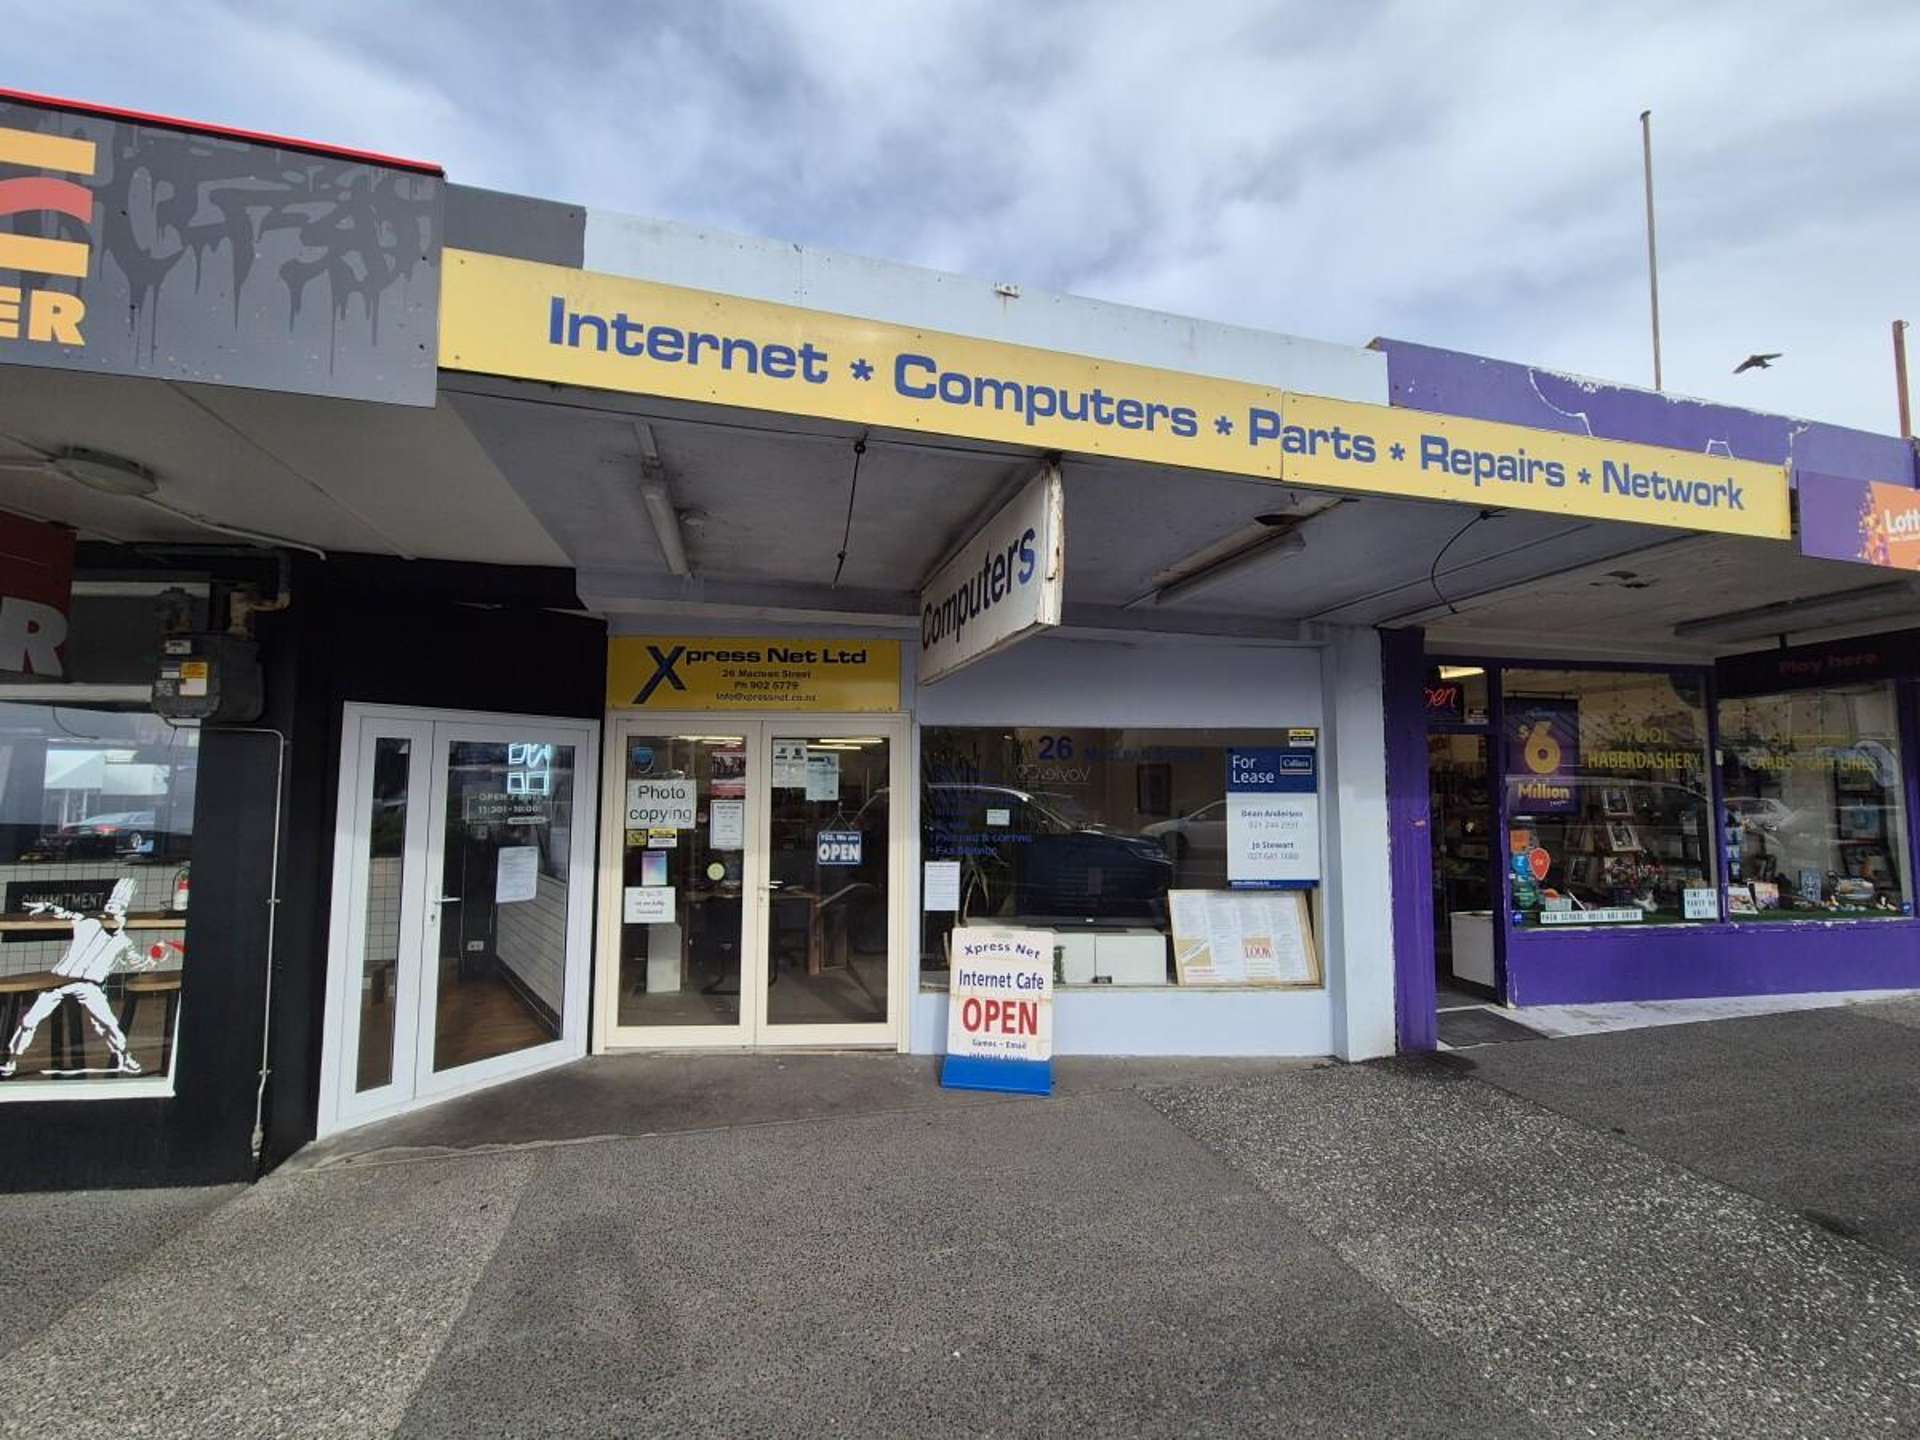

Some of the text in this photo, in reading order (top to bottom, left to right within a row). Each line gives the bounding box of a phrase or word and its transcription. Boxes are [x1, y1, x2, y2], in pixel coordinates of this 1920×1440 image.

[550, 299, 1744, 511] Internet Computers Parts Repairs Network
[922, 527, 1036, 651] Computers
[632, 644, 867, 704] Xpress Net Ltd
[782, 670, 811, 679] Street
[1038, 735, 1072, 760] 26
[1232, 755, 1256, 769] For
[1586, 751, 1702, 769] HABERDASHERY
[1232, 770, 1274, 784] Lease
[638, 784, 685, 799] Photo
[1518, 783, 1569, 801] Million
[630, 807, 692, 824] copying
[819, 843, 859, 860] OPEN
[1262, 840, 1294, 849] Stewart
[964, 942, 1040, 960] Xpress Net
[959, 969, 1044, 990] Internet Cafe
[962, 997, 1037, 1035] OPEN
[1006, 1041, 1026, 1049] Email
